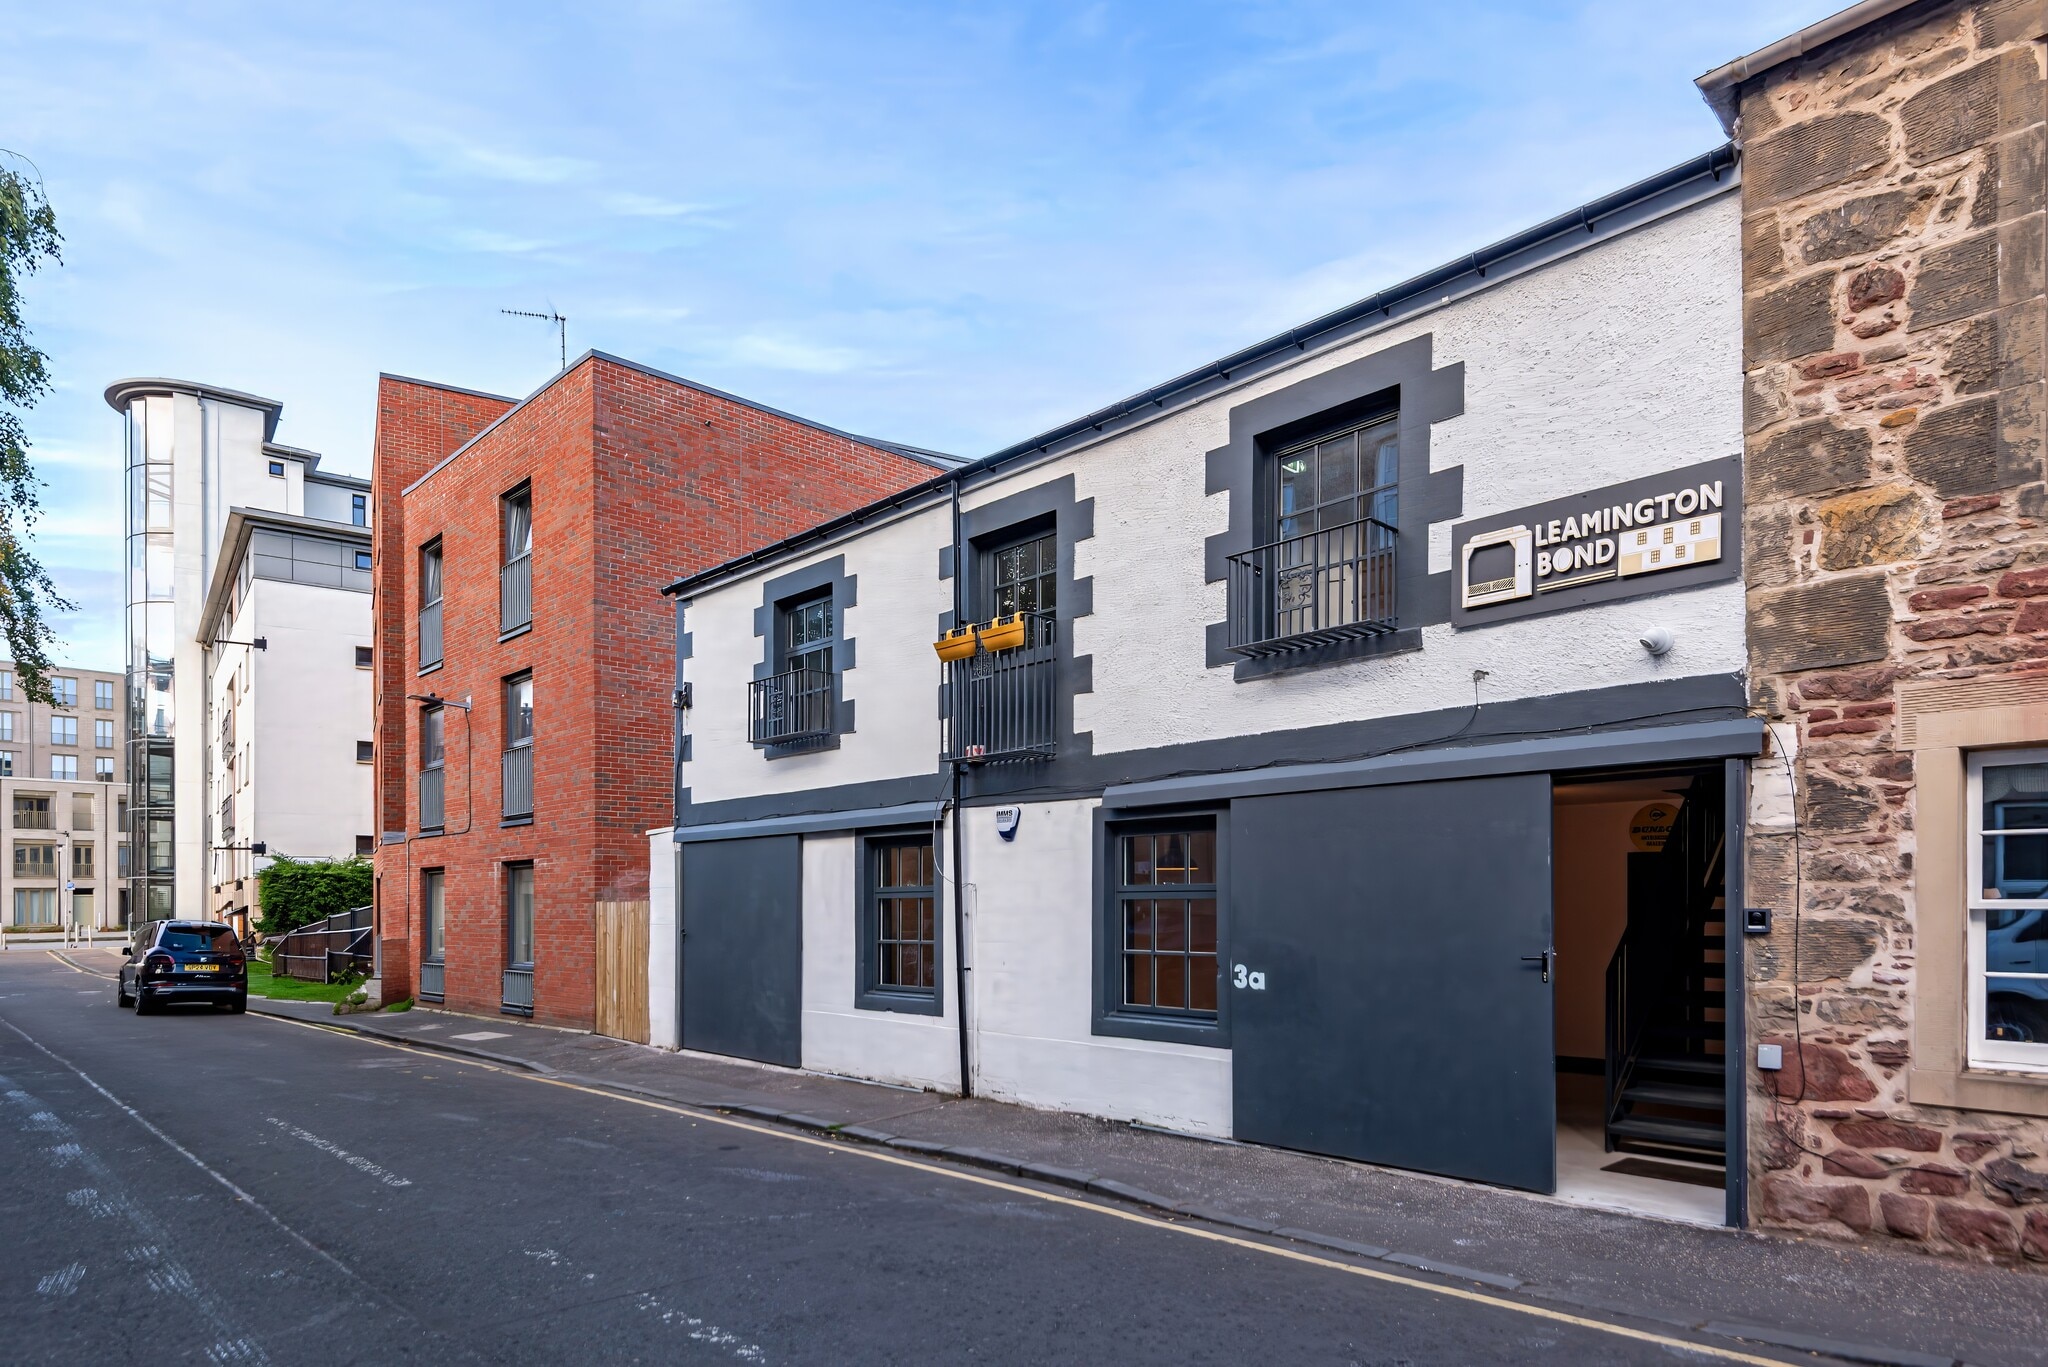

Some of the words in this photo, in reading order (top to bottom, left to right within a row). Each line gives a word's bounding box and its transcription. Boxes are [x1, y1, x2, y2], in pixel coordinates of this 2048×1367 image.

[1535, 480, 1723, 547] LEAMINGTON
[1537, 538, 1616, 577] BOND
[1233, 964, 1265, 990] 3a
